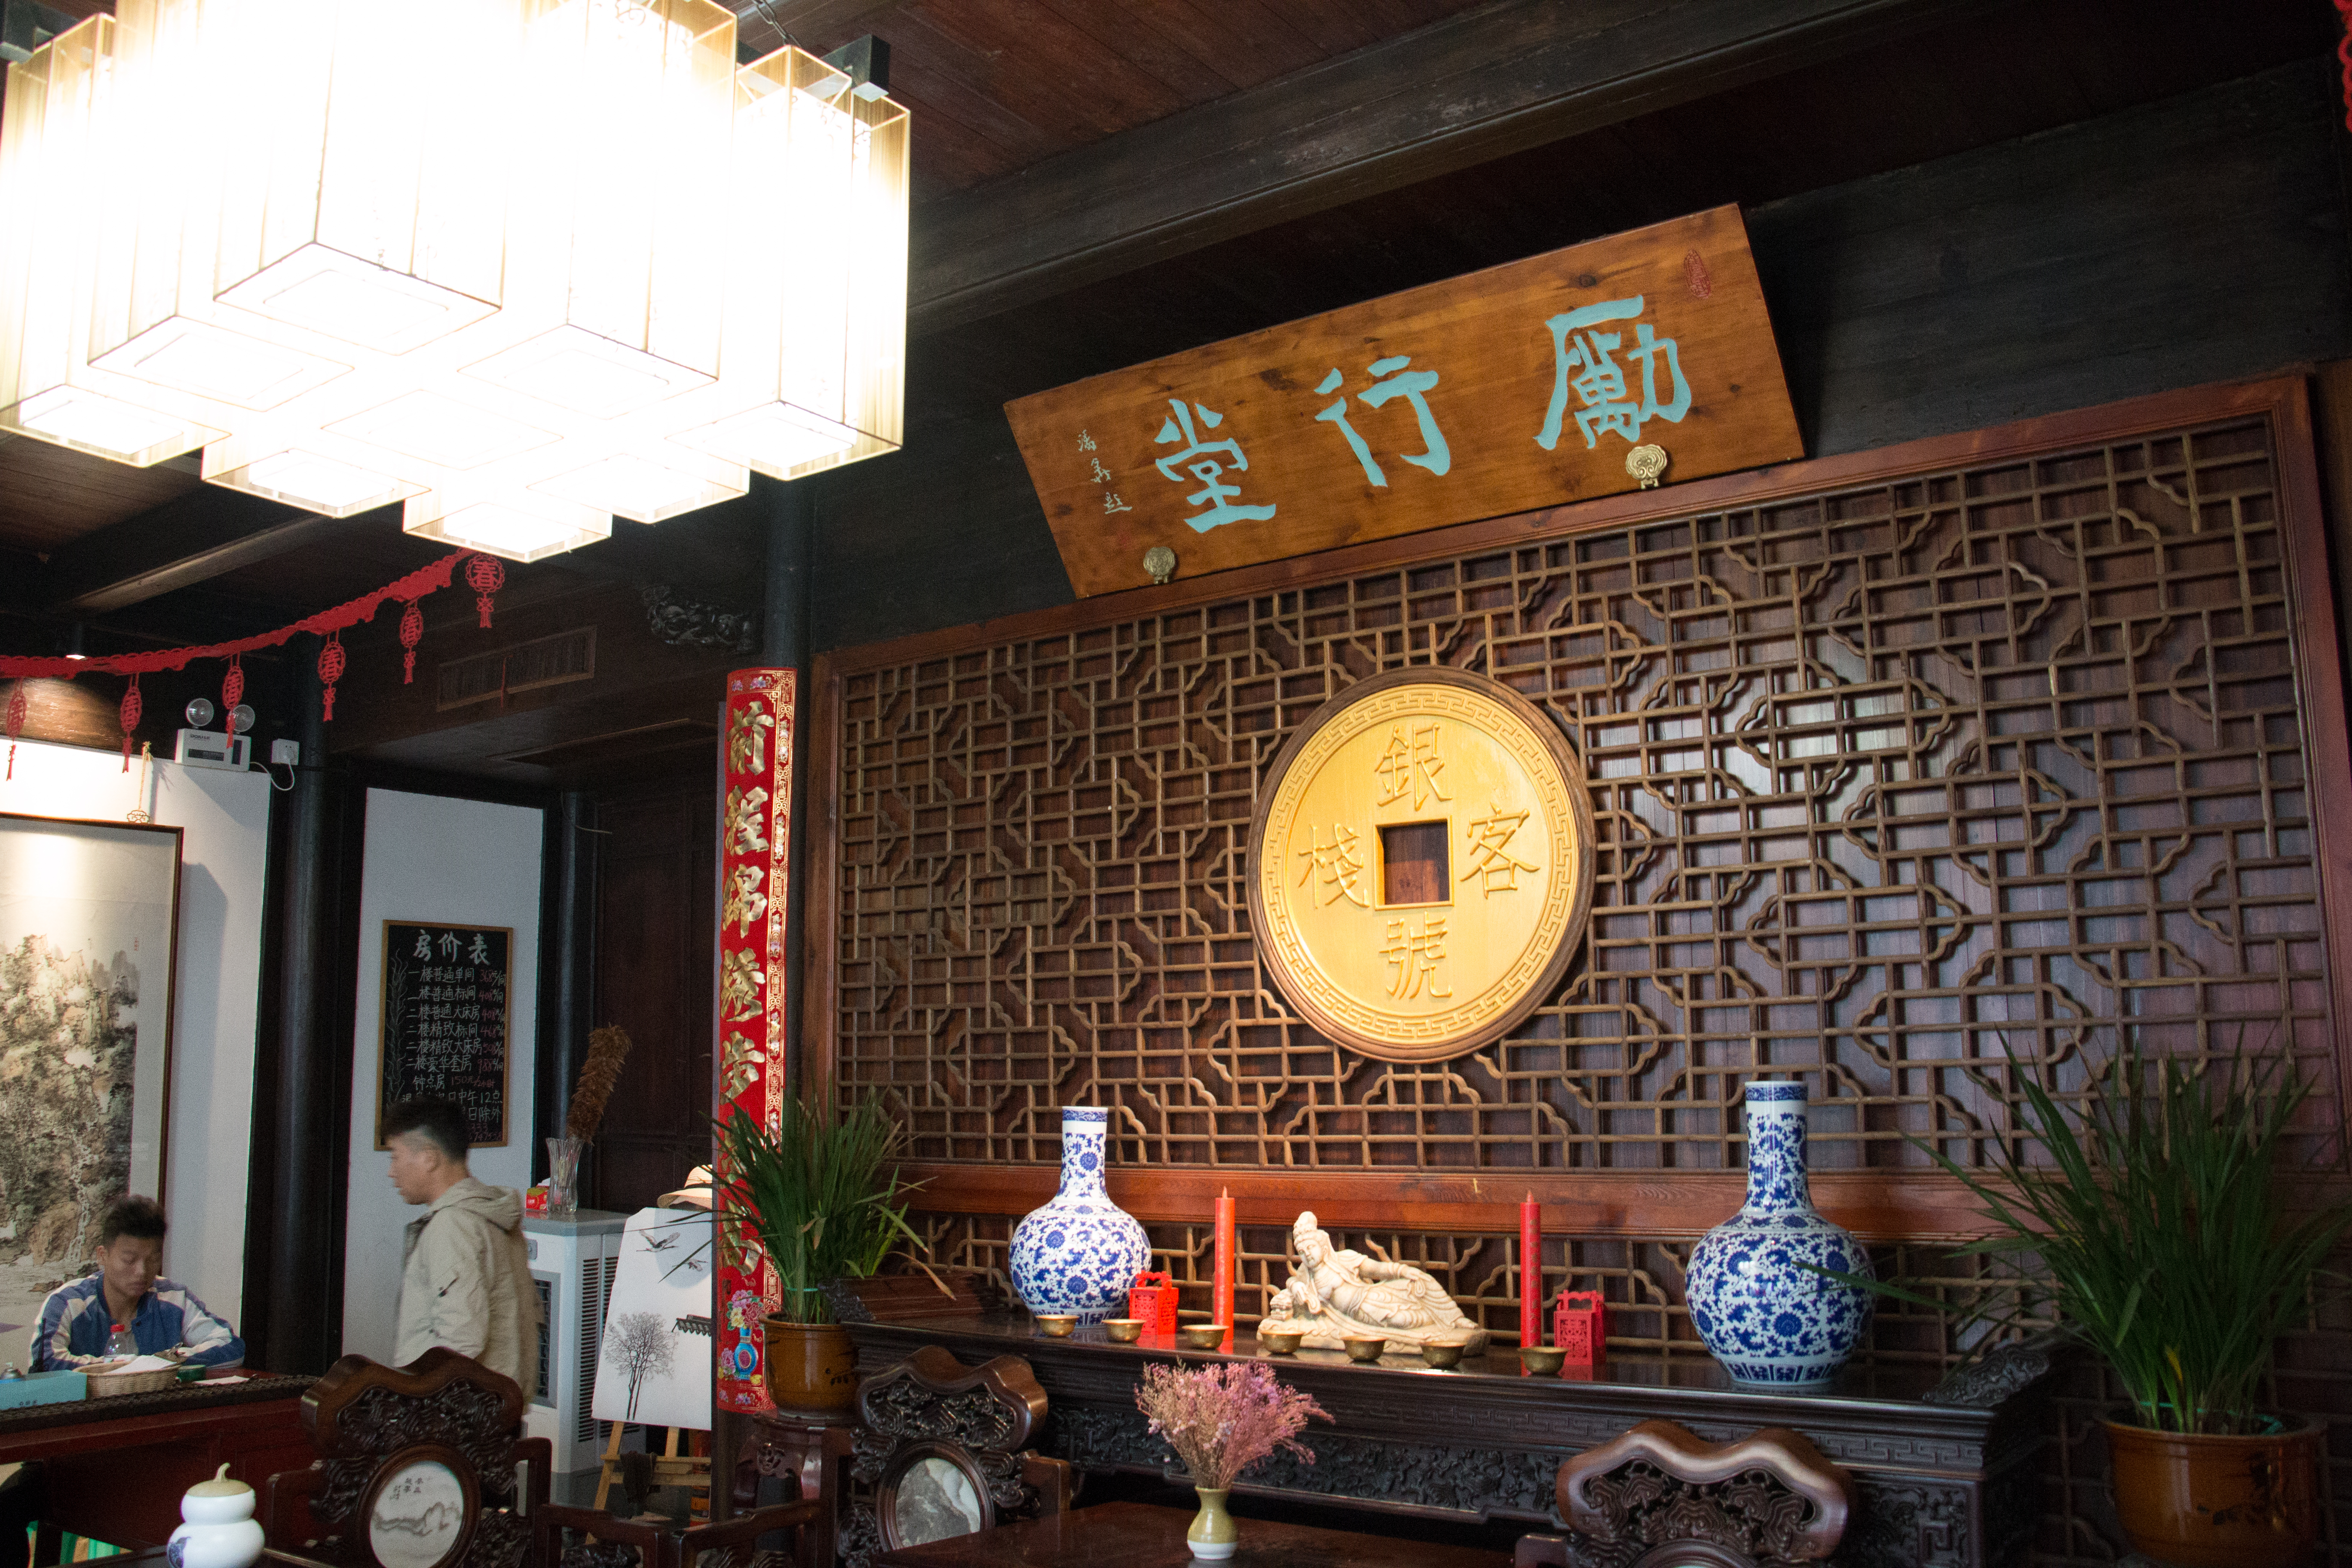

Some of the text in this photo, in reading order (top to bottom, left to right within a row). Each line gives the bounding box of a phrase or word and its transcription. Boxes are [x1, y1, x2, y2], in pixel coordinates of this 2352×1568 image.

[1374, 723, 1453, 812] 銀
[1461, 802, 1541, 899] 客
[413, 929, 490, 965] 房价表
[1379, 911, 1453, 1000] 號
[408, 965, 475, 983] 一楼普通单间
[406, 1003, 480, 1021] 二楼普通大床房
[406, 1020, 478, 1038] 二楼精致标间
[406, 1038, 482, 1056] 二楼精致大床房
[406, 1053, 472, 1072] 二楼豪华套房
[413, 1074, 445, 1090] 钟点房
